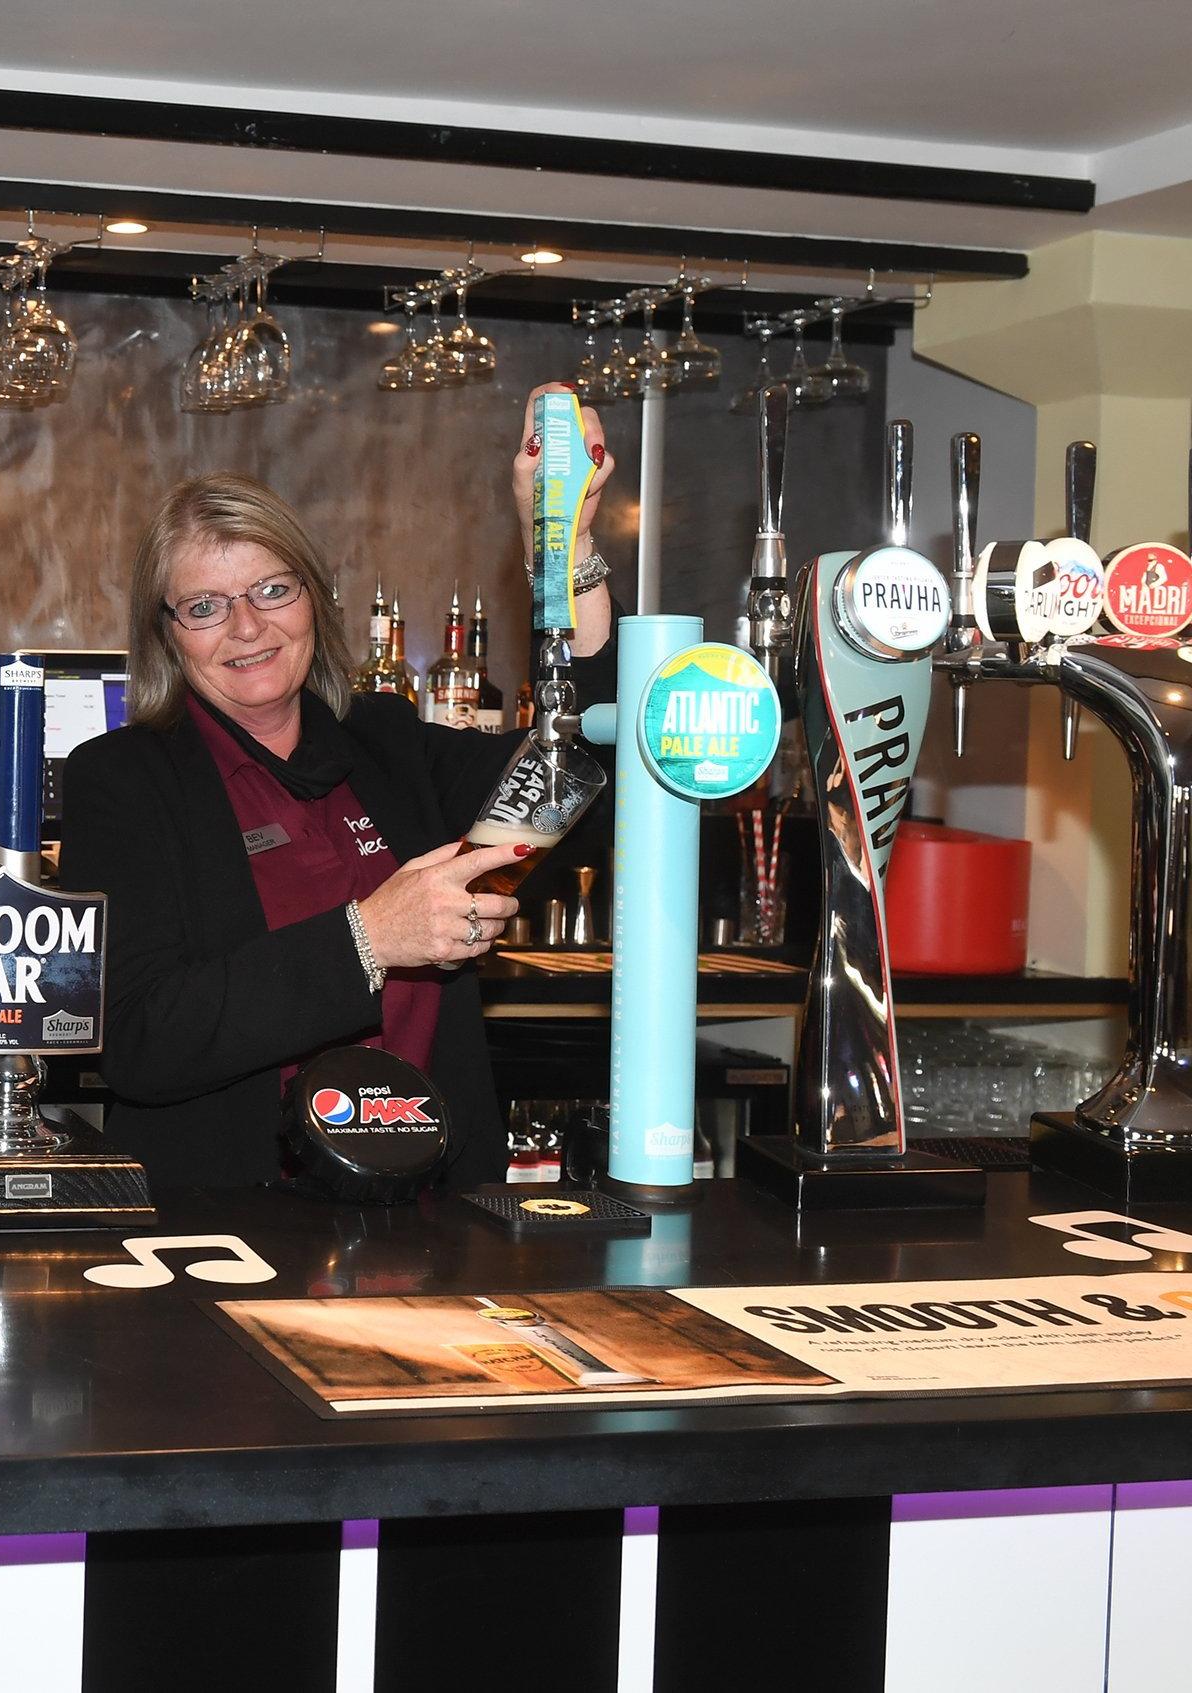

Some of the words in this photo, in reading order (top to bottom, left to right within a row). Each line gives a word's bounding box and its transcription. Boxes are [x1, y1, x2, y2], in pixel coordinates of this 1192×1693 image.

[547, 416, 571, 476] ATLANTIC
[862, 582, 941, 612] PRAVHA
[4, 670, 42, 678] SHARP'S
[661, 690, 760, 735] ATLANTIC
[660, 735, 703, 757] PALE
[707, 736, 740, 757] ALE
[844, 694, 911, 879] PRAV
[343, 816, 373, 833] he
[47, 1018, 90, 1035] Sharp's
[358, 1086, 391, 1097] pepsi
[612, 1033, 622, 1155] NATURALLY
[11, 1182, 48, 1192] ANGRAM
[743, 1298, 1102, 1334] SMOOTH
[1080, 1293, 1187, 1322] &
